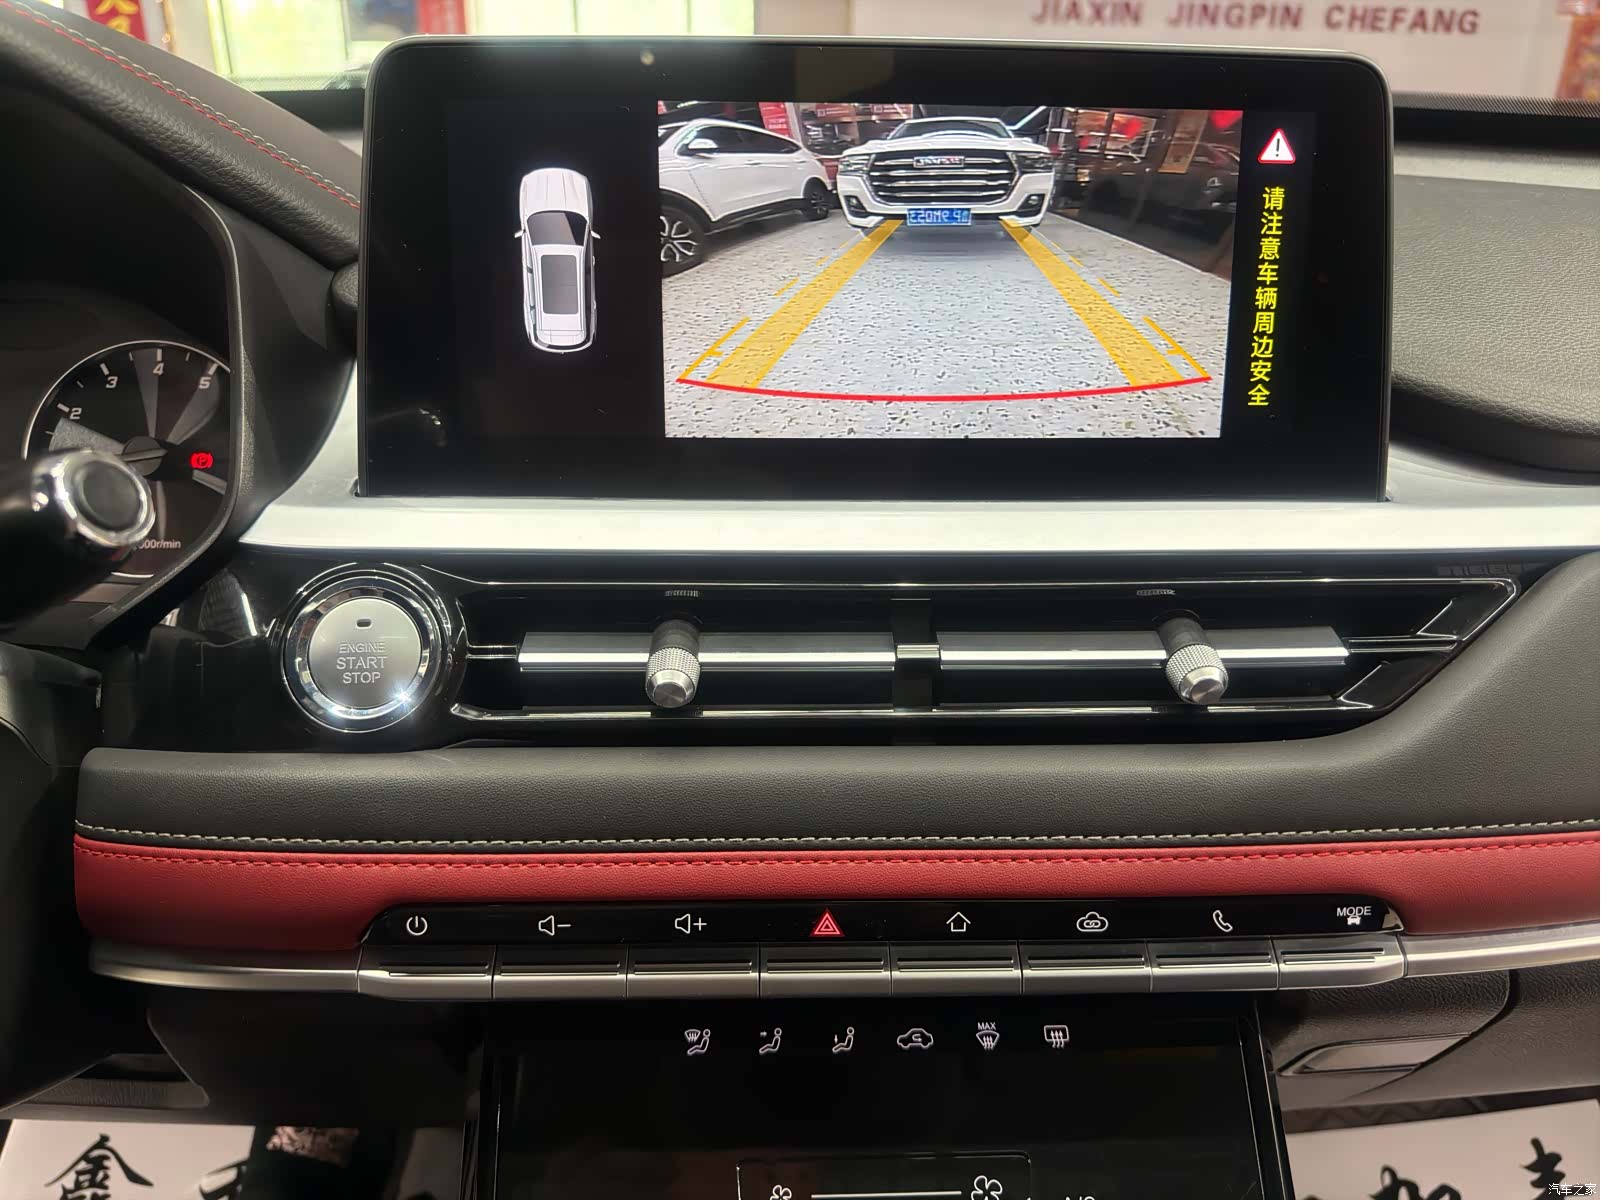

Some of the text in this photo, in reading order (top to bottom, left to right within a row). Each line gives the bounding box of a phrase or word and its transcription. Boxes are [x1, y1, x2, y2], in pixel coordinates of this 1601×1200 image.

[1031, 0, 1480, 35] JIAXIN JINGPIN CHEFANG
[1247, 186, 1285, 406] 请注意车辆周边安全
[153, 363, 164, 375] 4
[105, 376, 118, 388] 3
[198, 377, 211, 389] 5
[69, 407, 82, 420] 2
[339, 643, 385, 653] ENGINE
[336, 656, 386, 670] START
[343, 671, 381, 684] STOP
[1336, 905, 1372, 917] MODE
[977, 1021, 997, 1031] MAX
